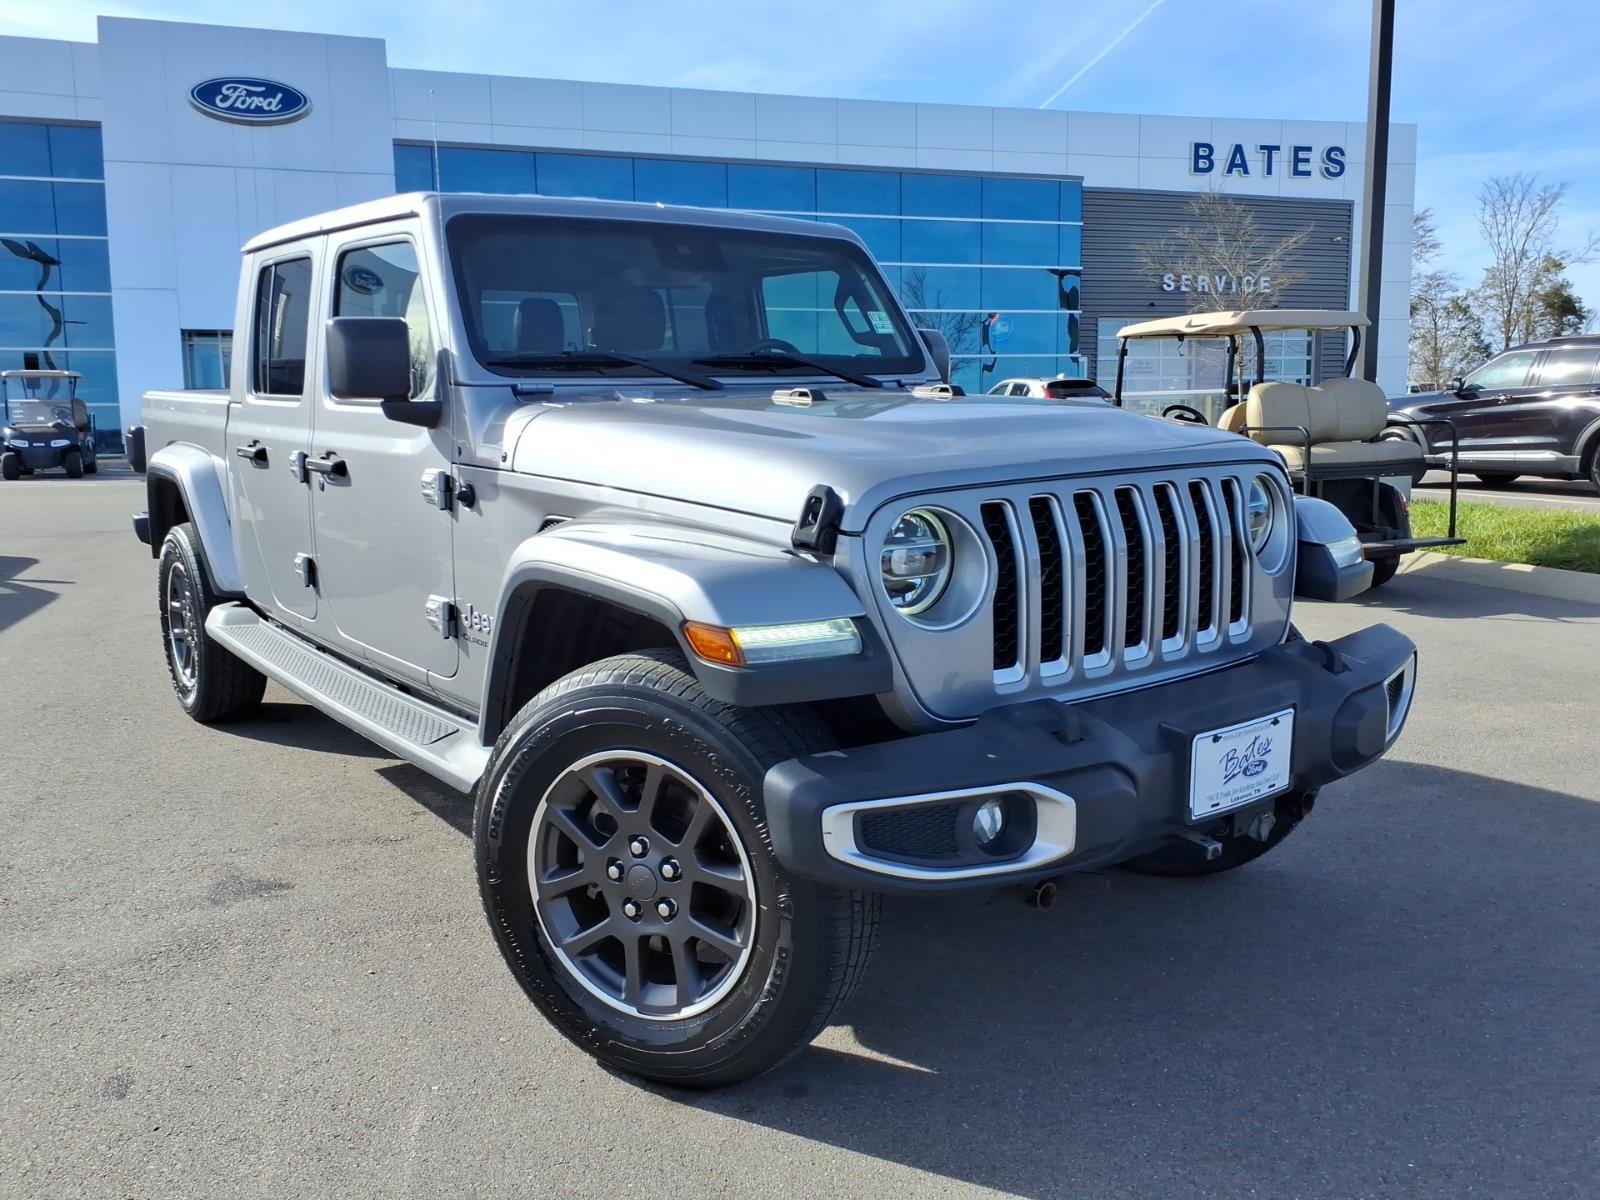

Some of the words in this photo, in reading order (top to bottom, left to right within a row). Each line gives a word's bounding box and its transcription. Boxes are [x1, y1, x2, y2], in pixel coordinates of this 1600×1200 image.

[215, 83, 283, 112] Ford
[1191, 142, 1346, 178] BATES
[1162, 273, 1272, 294] SERVICE
[461, 603, 494, 635] Jee
[1219, 735, 1273, 782] Bates
[1245, 761, 1266, 775] Ford
